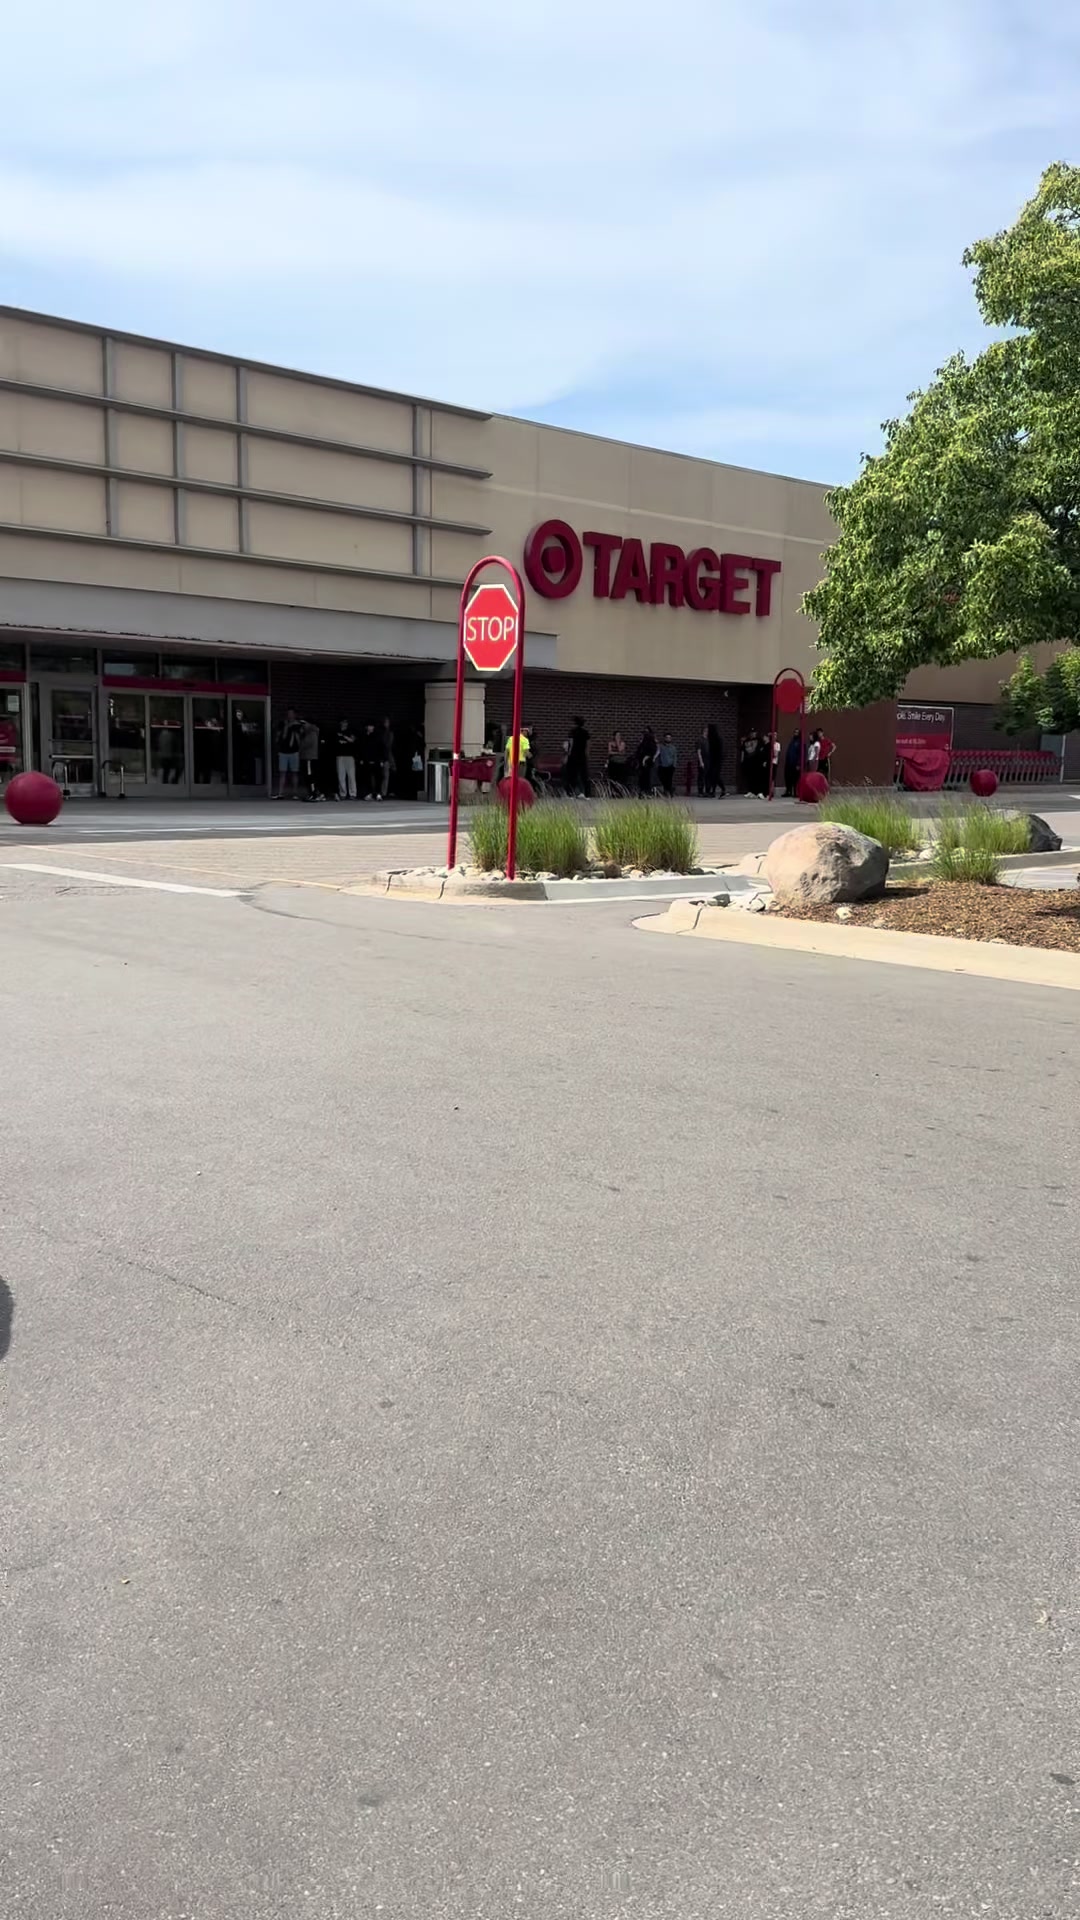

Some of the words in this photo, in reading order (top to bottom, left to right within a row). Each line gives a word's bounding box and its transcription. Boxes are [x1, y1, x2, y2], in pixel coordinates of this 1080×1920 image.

[583, 531, 781, 616] TARGET
[467, 616, 514, 641] STOP
[935, 712, 945, 723] Day
